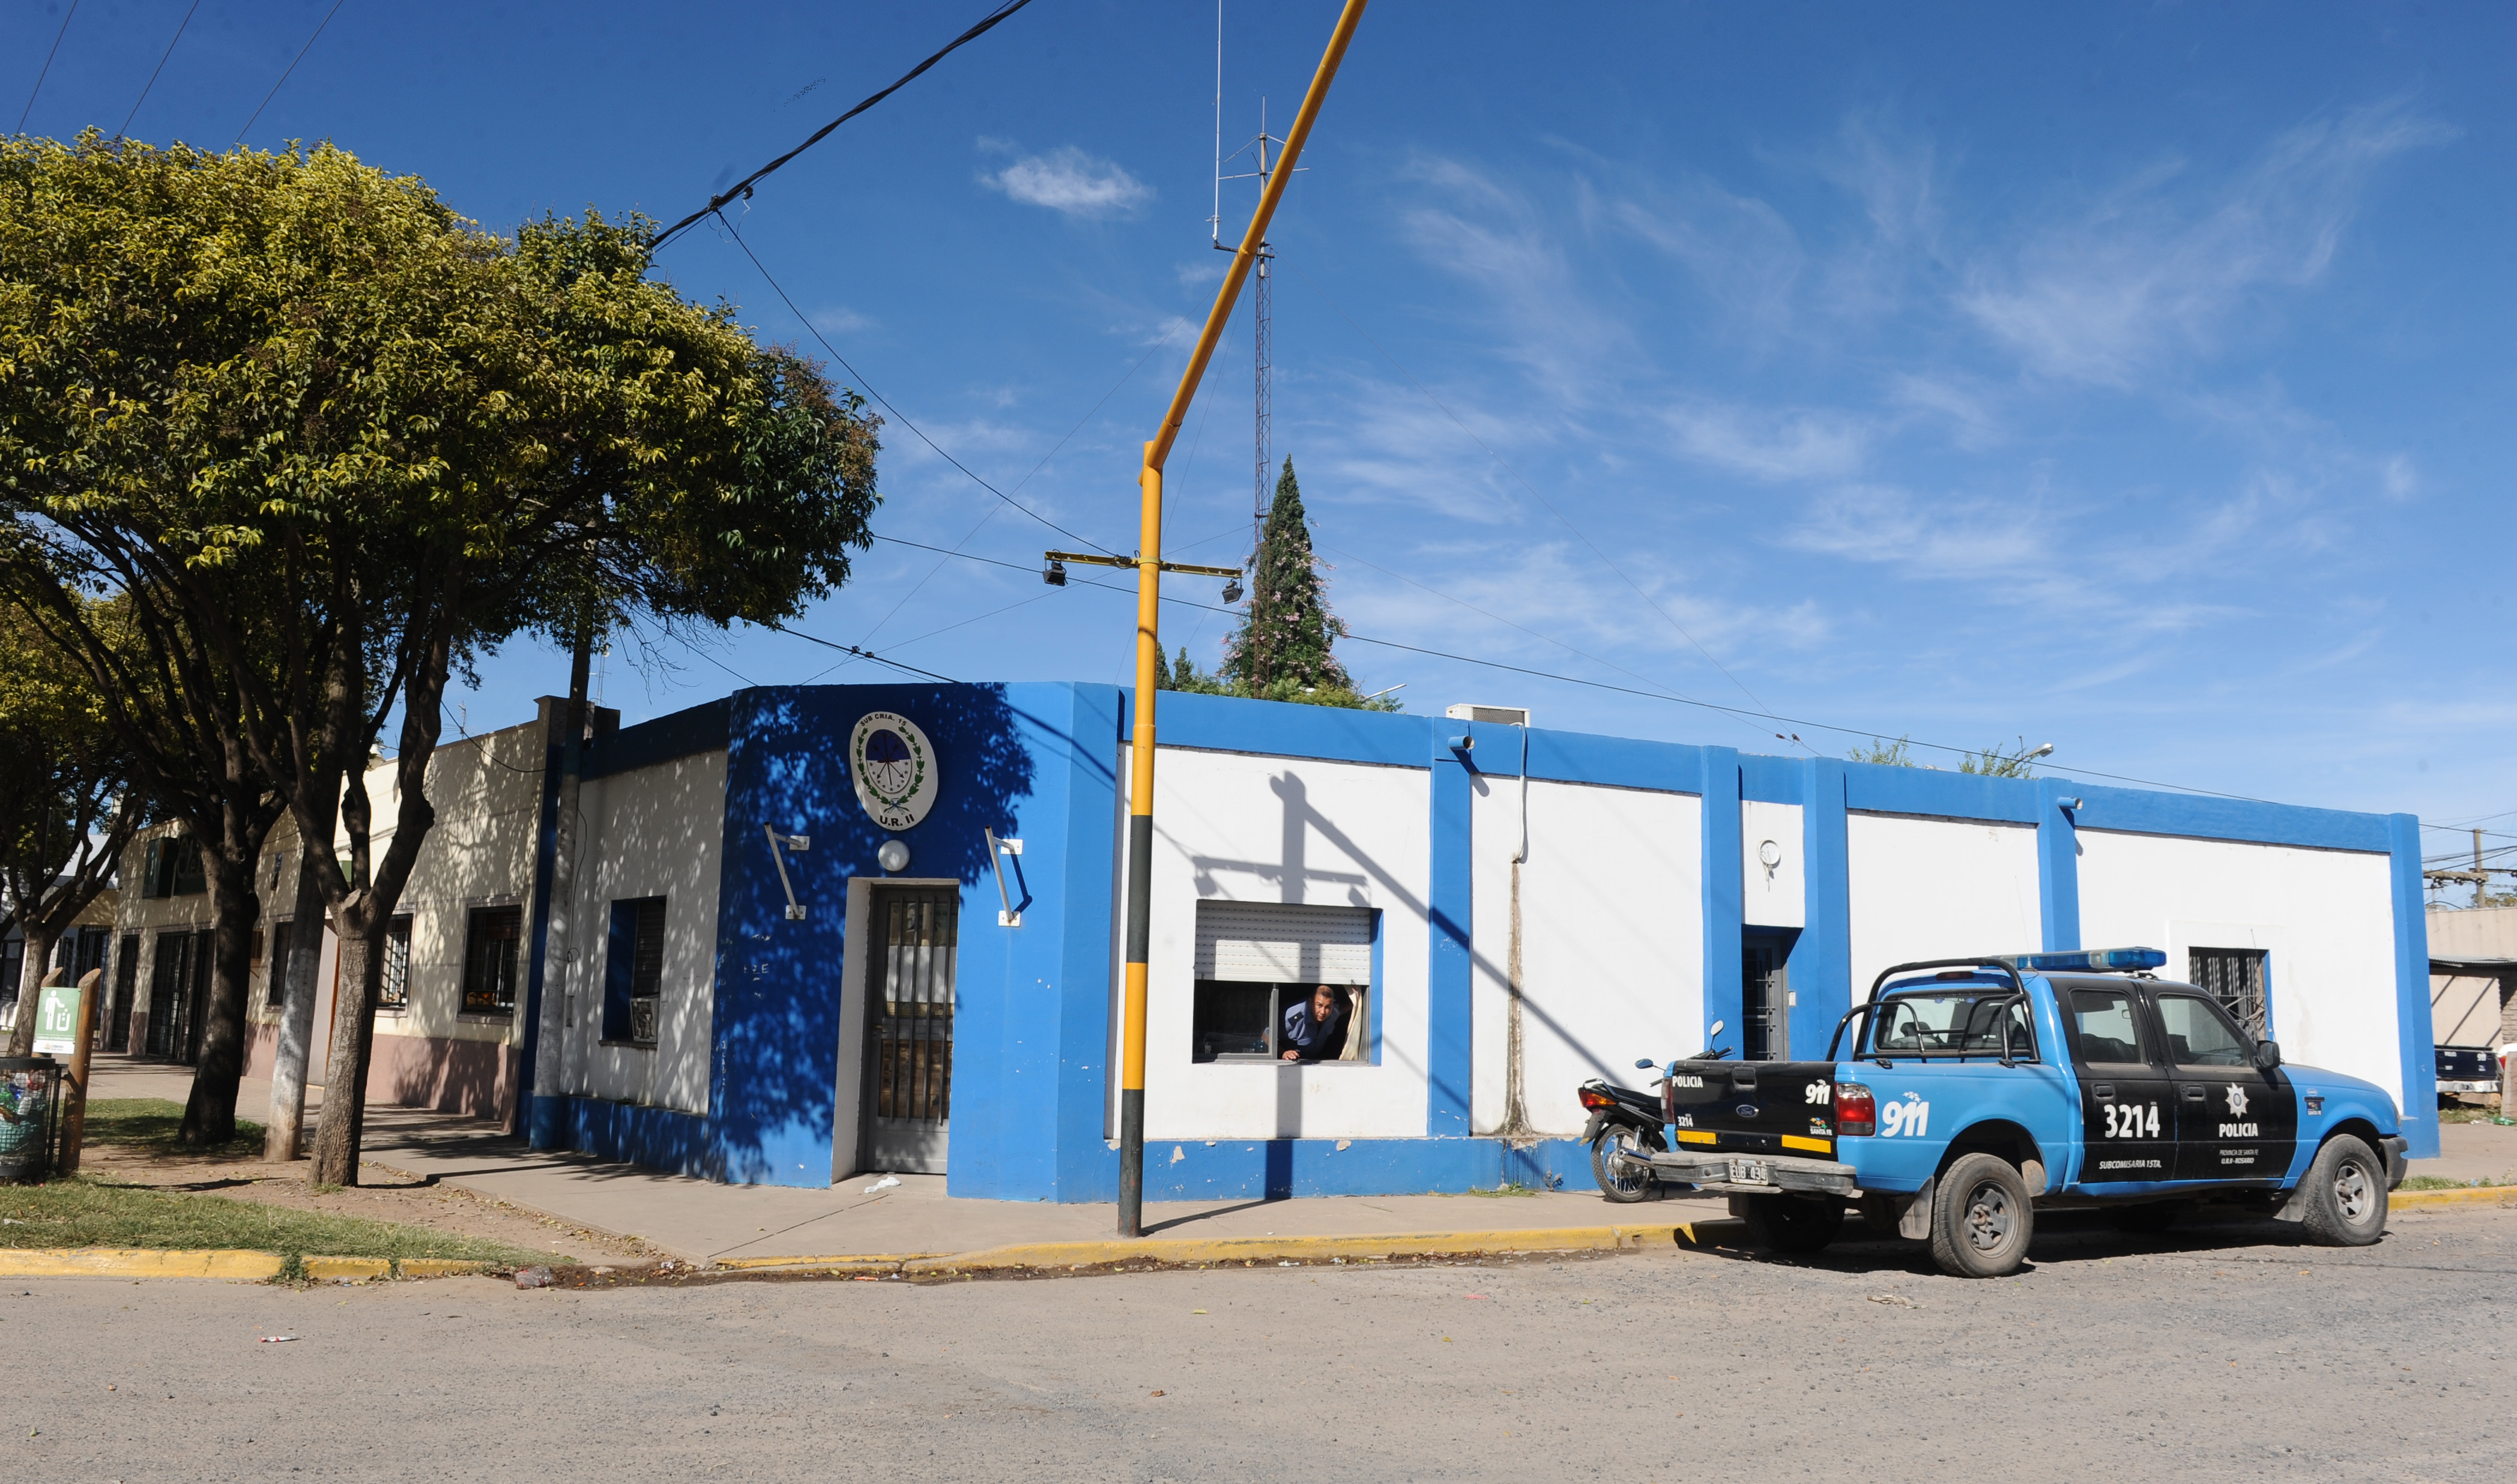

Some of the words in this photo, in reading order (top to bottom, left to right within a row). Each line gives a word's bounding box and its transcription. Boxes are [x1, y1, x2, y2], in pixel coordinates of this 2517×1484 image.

[860, 716, 873, 726] SUB
[880, 815, 903, 827] U.R.
[905, 813, 915, 824] II
[1672, 1076, 1703, 1088] POLICIA
[1805, 1084, 1831, 1105] 911
[1677, 1115, 1694, 1127] 3214
[1881, 1101, 1929, 1138] 911
[2103, 1104, 2160, 1138] 3214
[2219, 1123, 2259, 1138] POLICIA
[2099, 1159, 2145, 1169] SUBCOMISARIA
[1730, 1165, 1747, 1179] EUB
